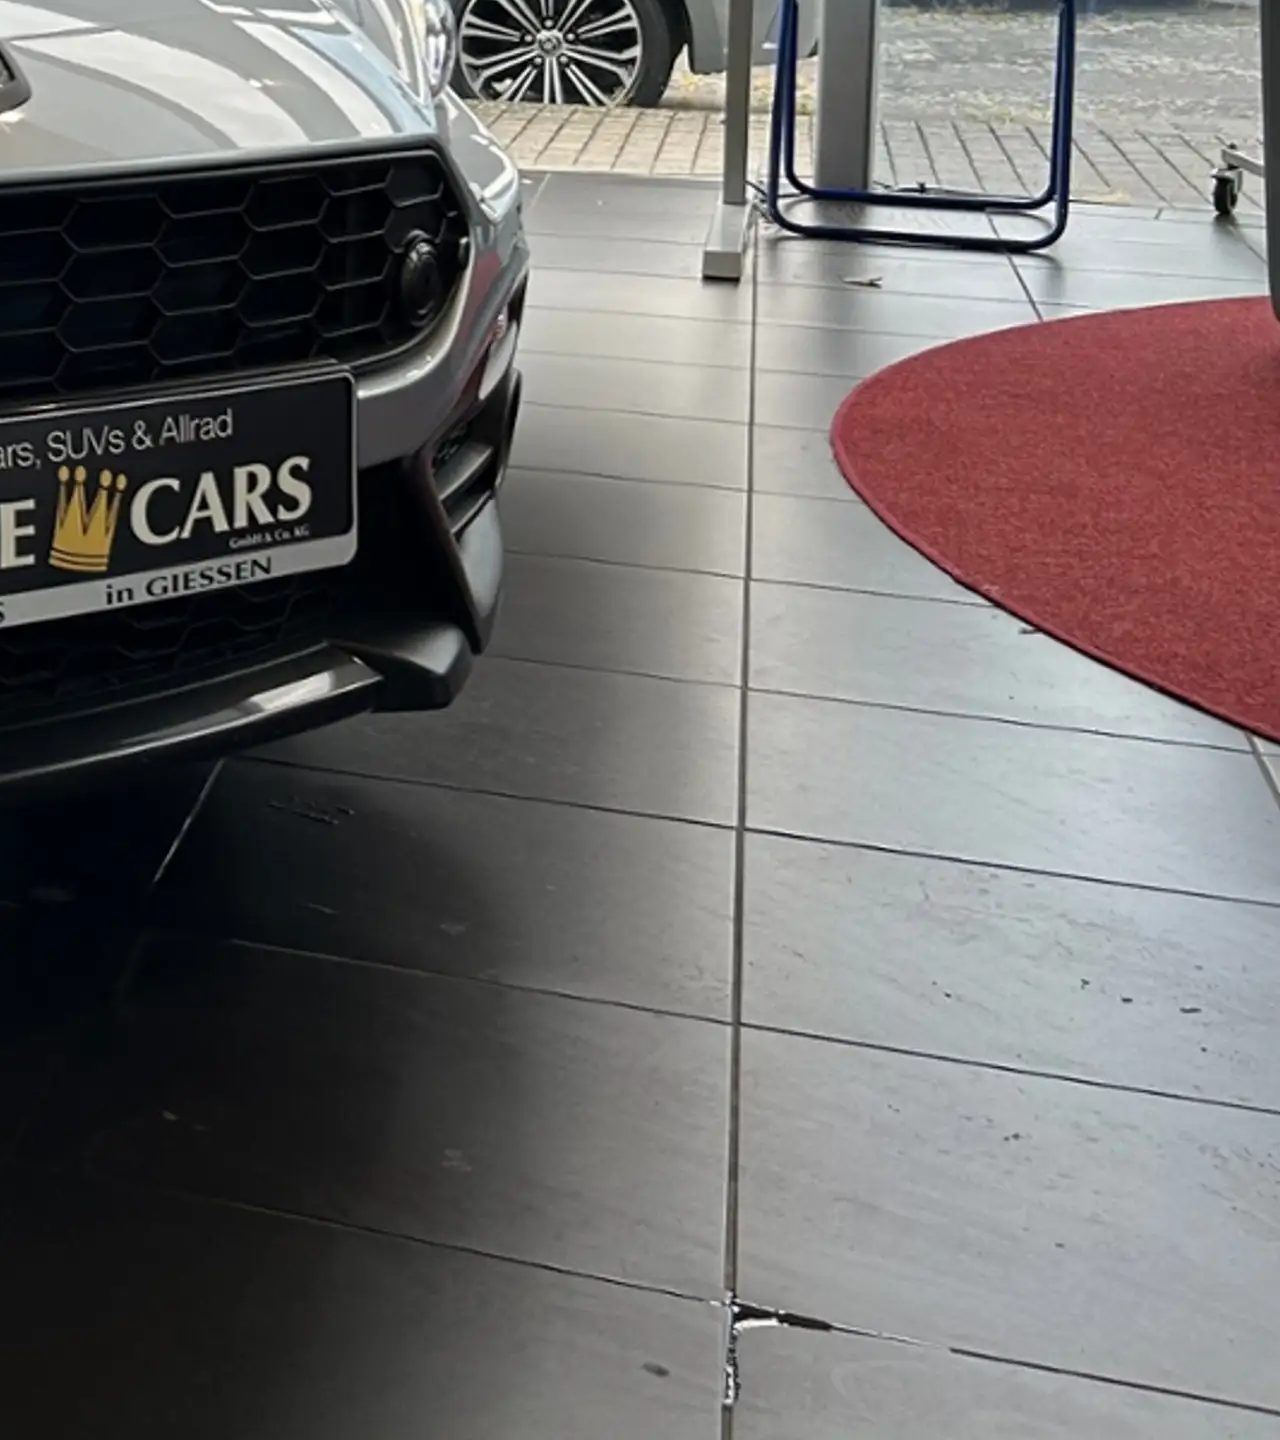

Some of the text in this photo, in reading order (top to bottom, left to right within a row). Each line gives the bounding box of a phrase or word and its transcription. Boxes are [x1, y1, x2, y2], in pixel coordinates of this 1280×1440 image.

[46, 425, 125, 462] SUVs
[131, 420, 153, 450] &
[158, 408, 233, 446] Allrad
[130, 455, 313, 546] CARS
[106, 556, 273, 606] in GIESSEN
